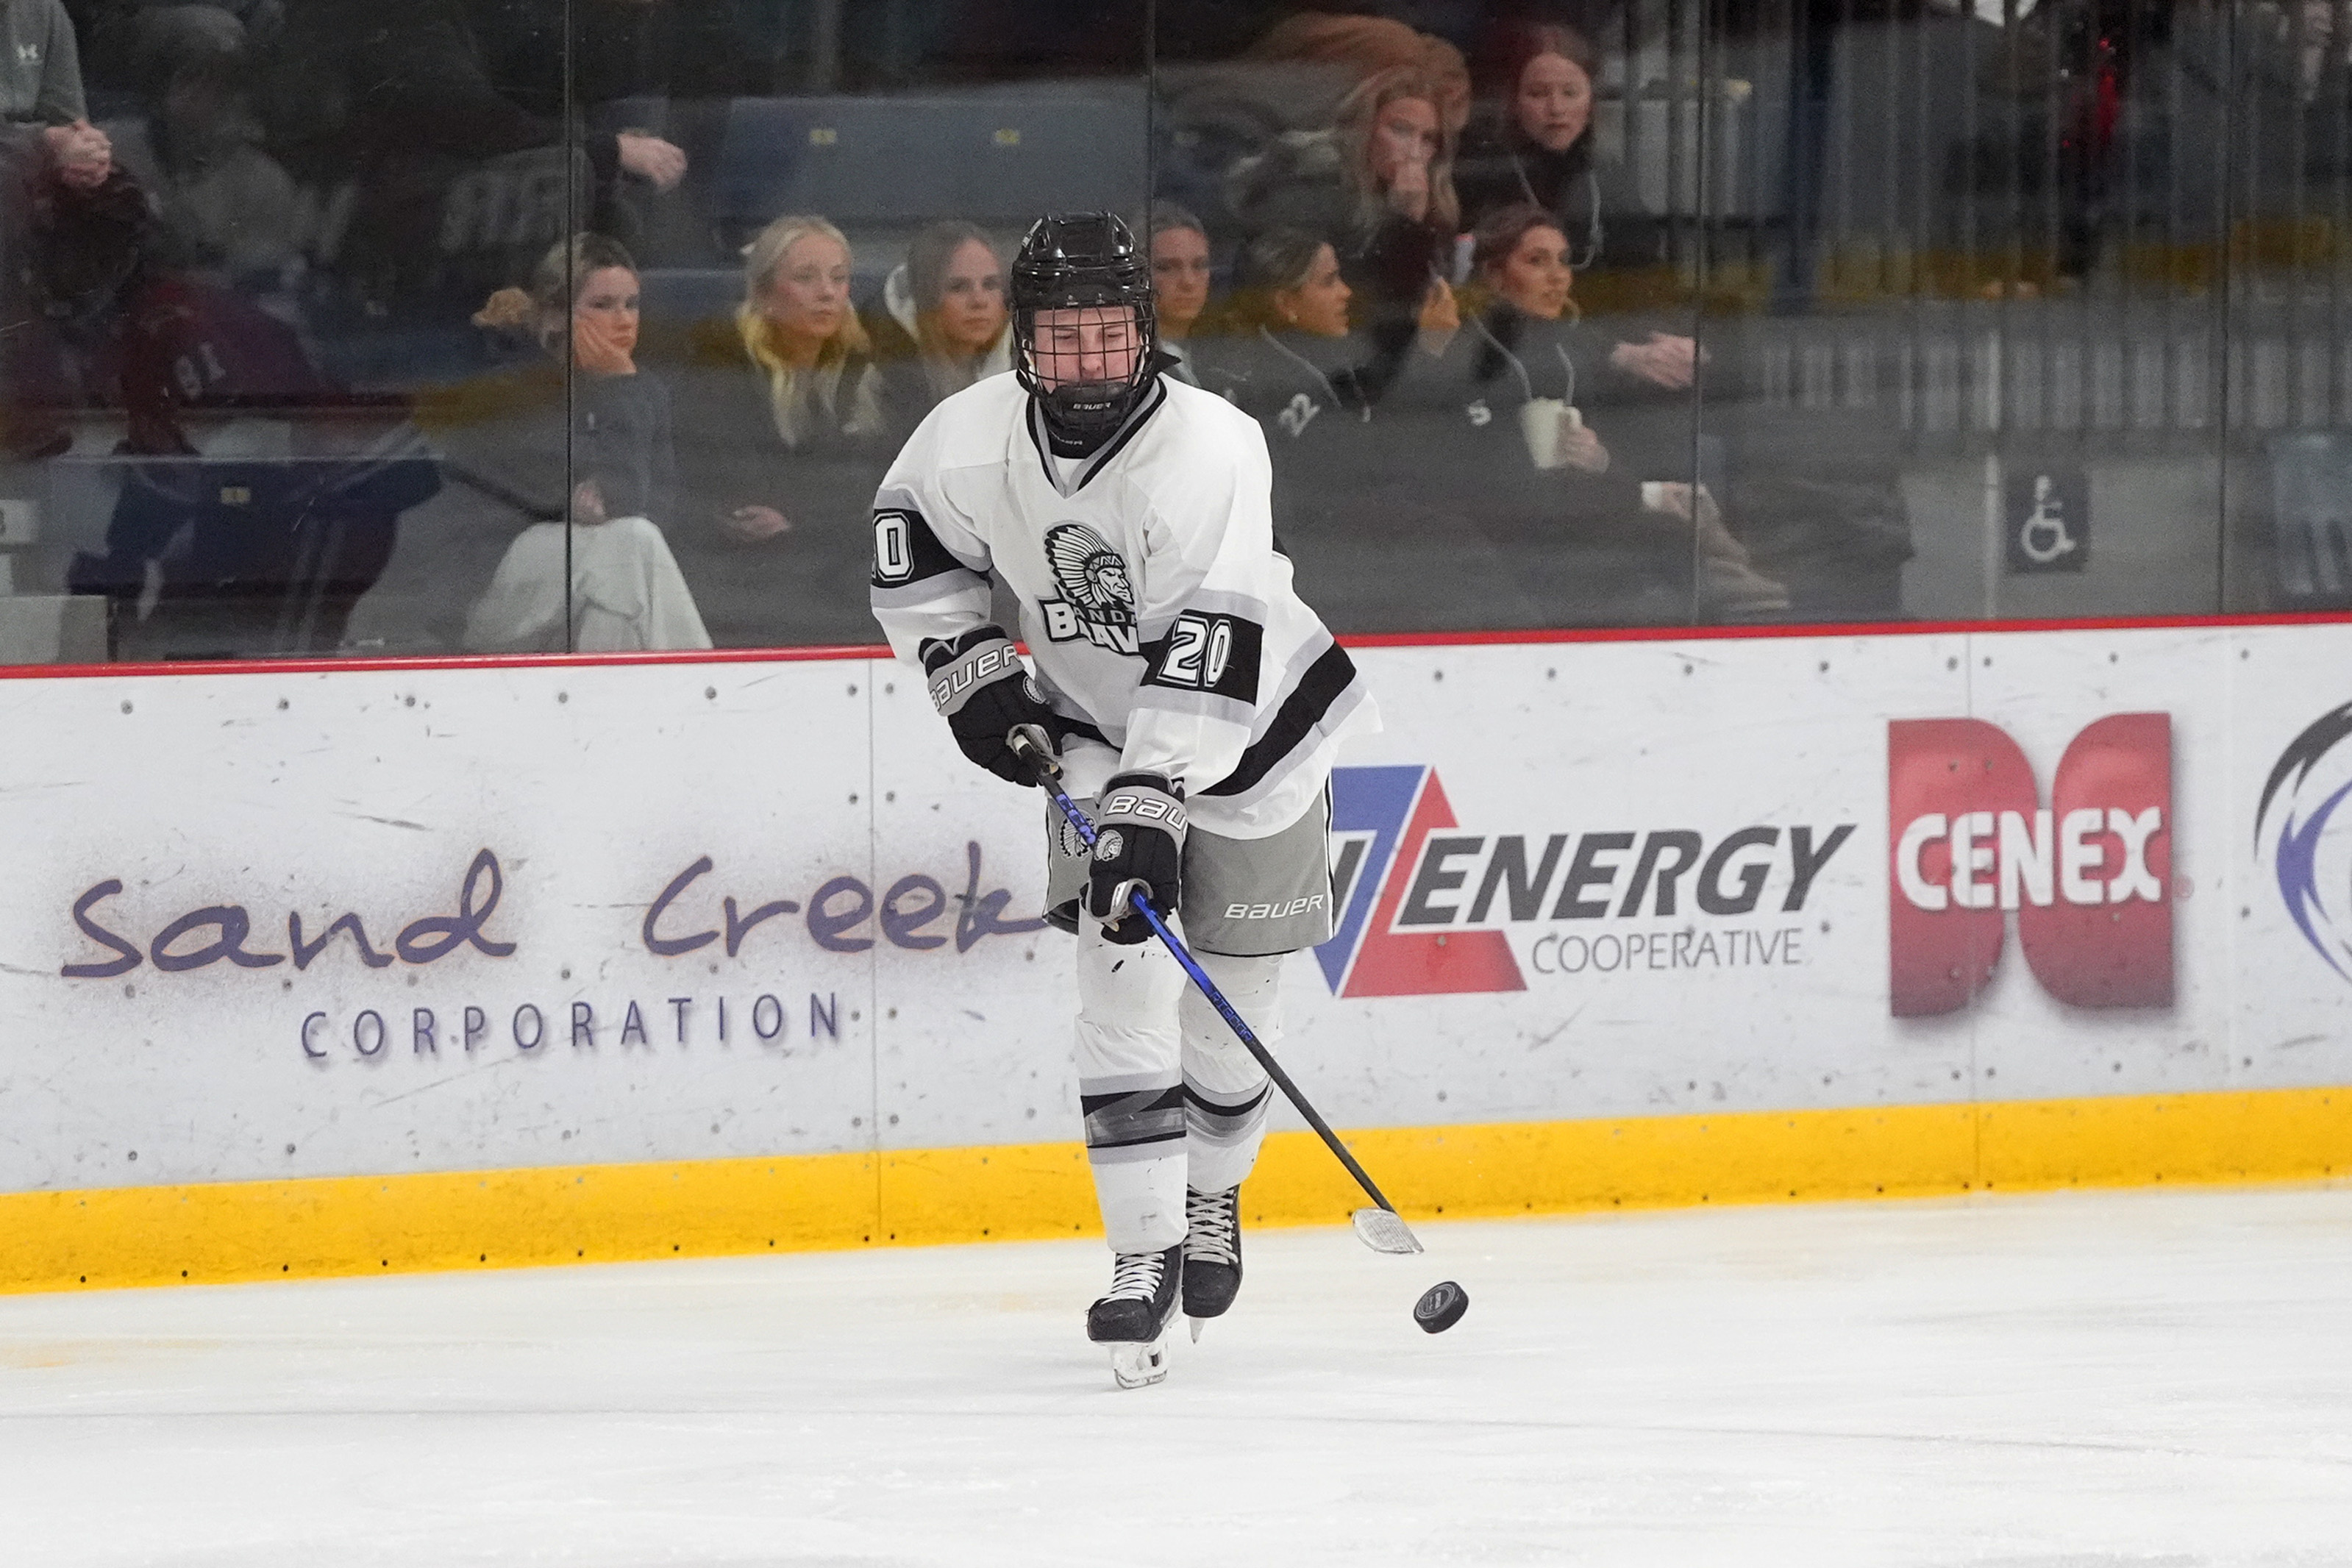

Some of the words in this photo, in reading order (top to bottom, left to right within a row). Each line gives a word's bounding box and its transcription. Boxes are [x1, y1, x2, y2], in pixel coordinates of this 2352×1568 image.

[1278, 393, 1321, 438] 22
[871, 511, 914, 582] 0
[1041, 601, 1140, 655] BAV
[1157, 614, 1233, 688] 20
[1397, 823, 1859, 925] ENERGY
[1897, 805, 2162, 910] CENEX
[60, 847, 516, 978] Sand
[642, 839, 1047, 957] Creek
[1532, 927, 1803, 974] COOPERATIVE
[301, 992, 837, 1058] CORPORATION
